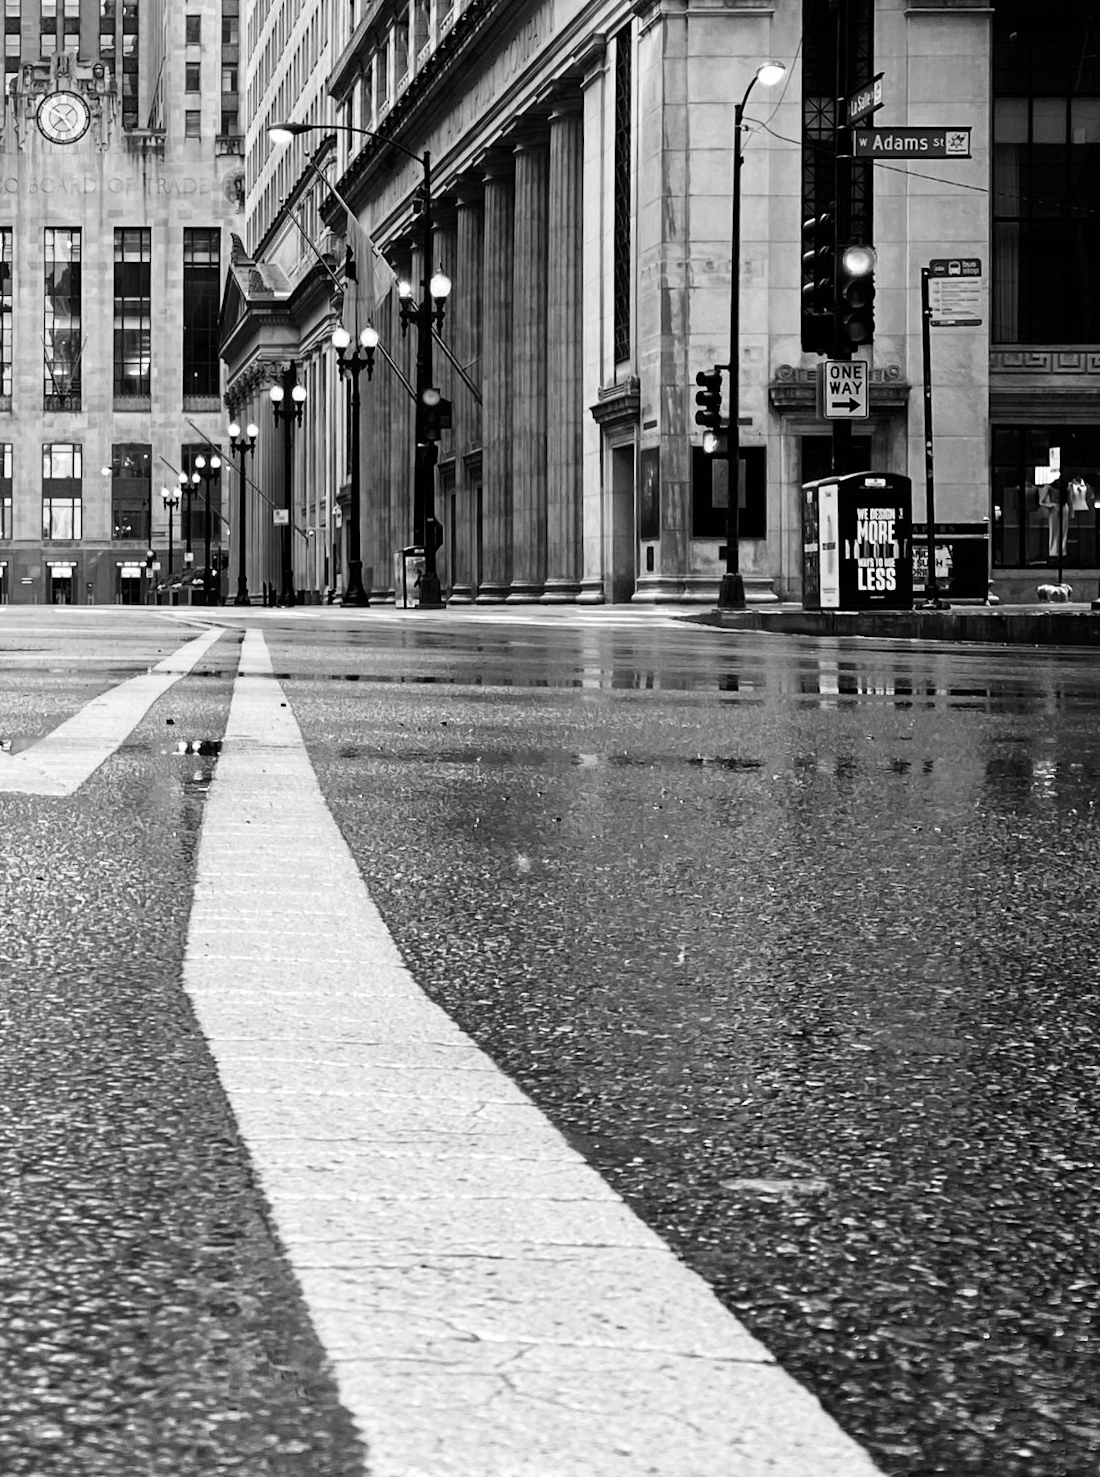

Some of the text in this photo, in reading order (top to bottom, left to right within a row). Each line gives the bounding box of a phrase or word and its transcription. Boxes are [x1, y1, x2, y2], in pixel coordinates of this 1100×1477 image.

[859, 134, 944, 151] W Adams St
[29, 177, 97, 195] BOARD
[108, 177, 134, 195] OF
[146, 177, 209, 196] TRADE
[963, 267, 980, 275] stop
[830, 366, 863, 380] ONE
[830, 382, 863, 395] WAY
[857, 508, 868, 520] WE
[857, 520, 896, 545] MORE
[857, 568, 896, 591] LESS
